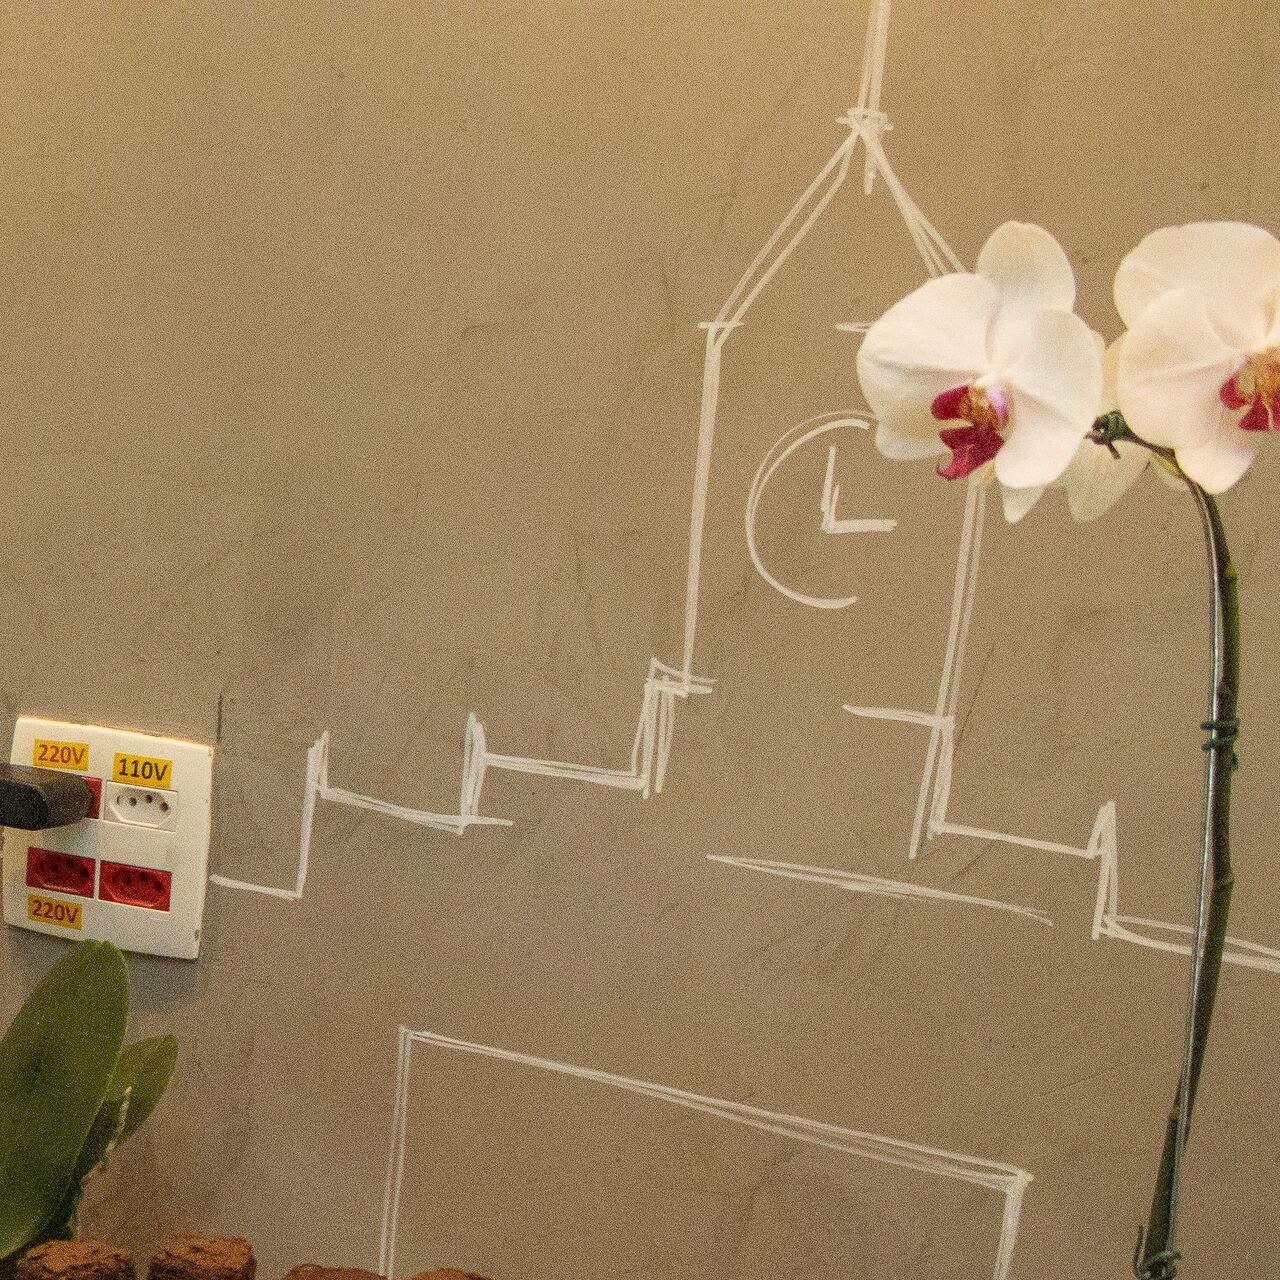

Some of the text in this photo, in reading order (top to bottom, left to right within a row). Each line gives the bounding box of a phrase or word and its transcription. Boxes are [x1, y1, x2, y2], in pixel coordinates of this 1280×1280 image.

[37, 744, 86, 765] 220V
[118, 758, 168, 781] 110V
[31, 900, 79, 924] 220V
